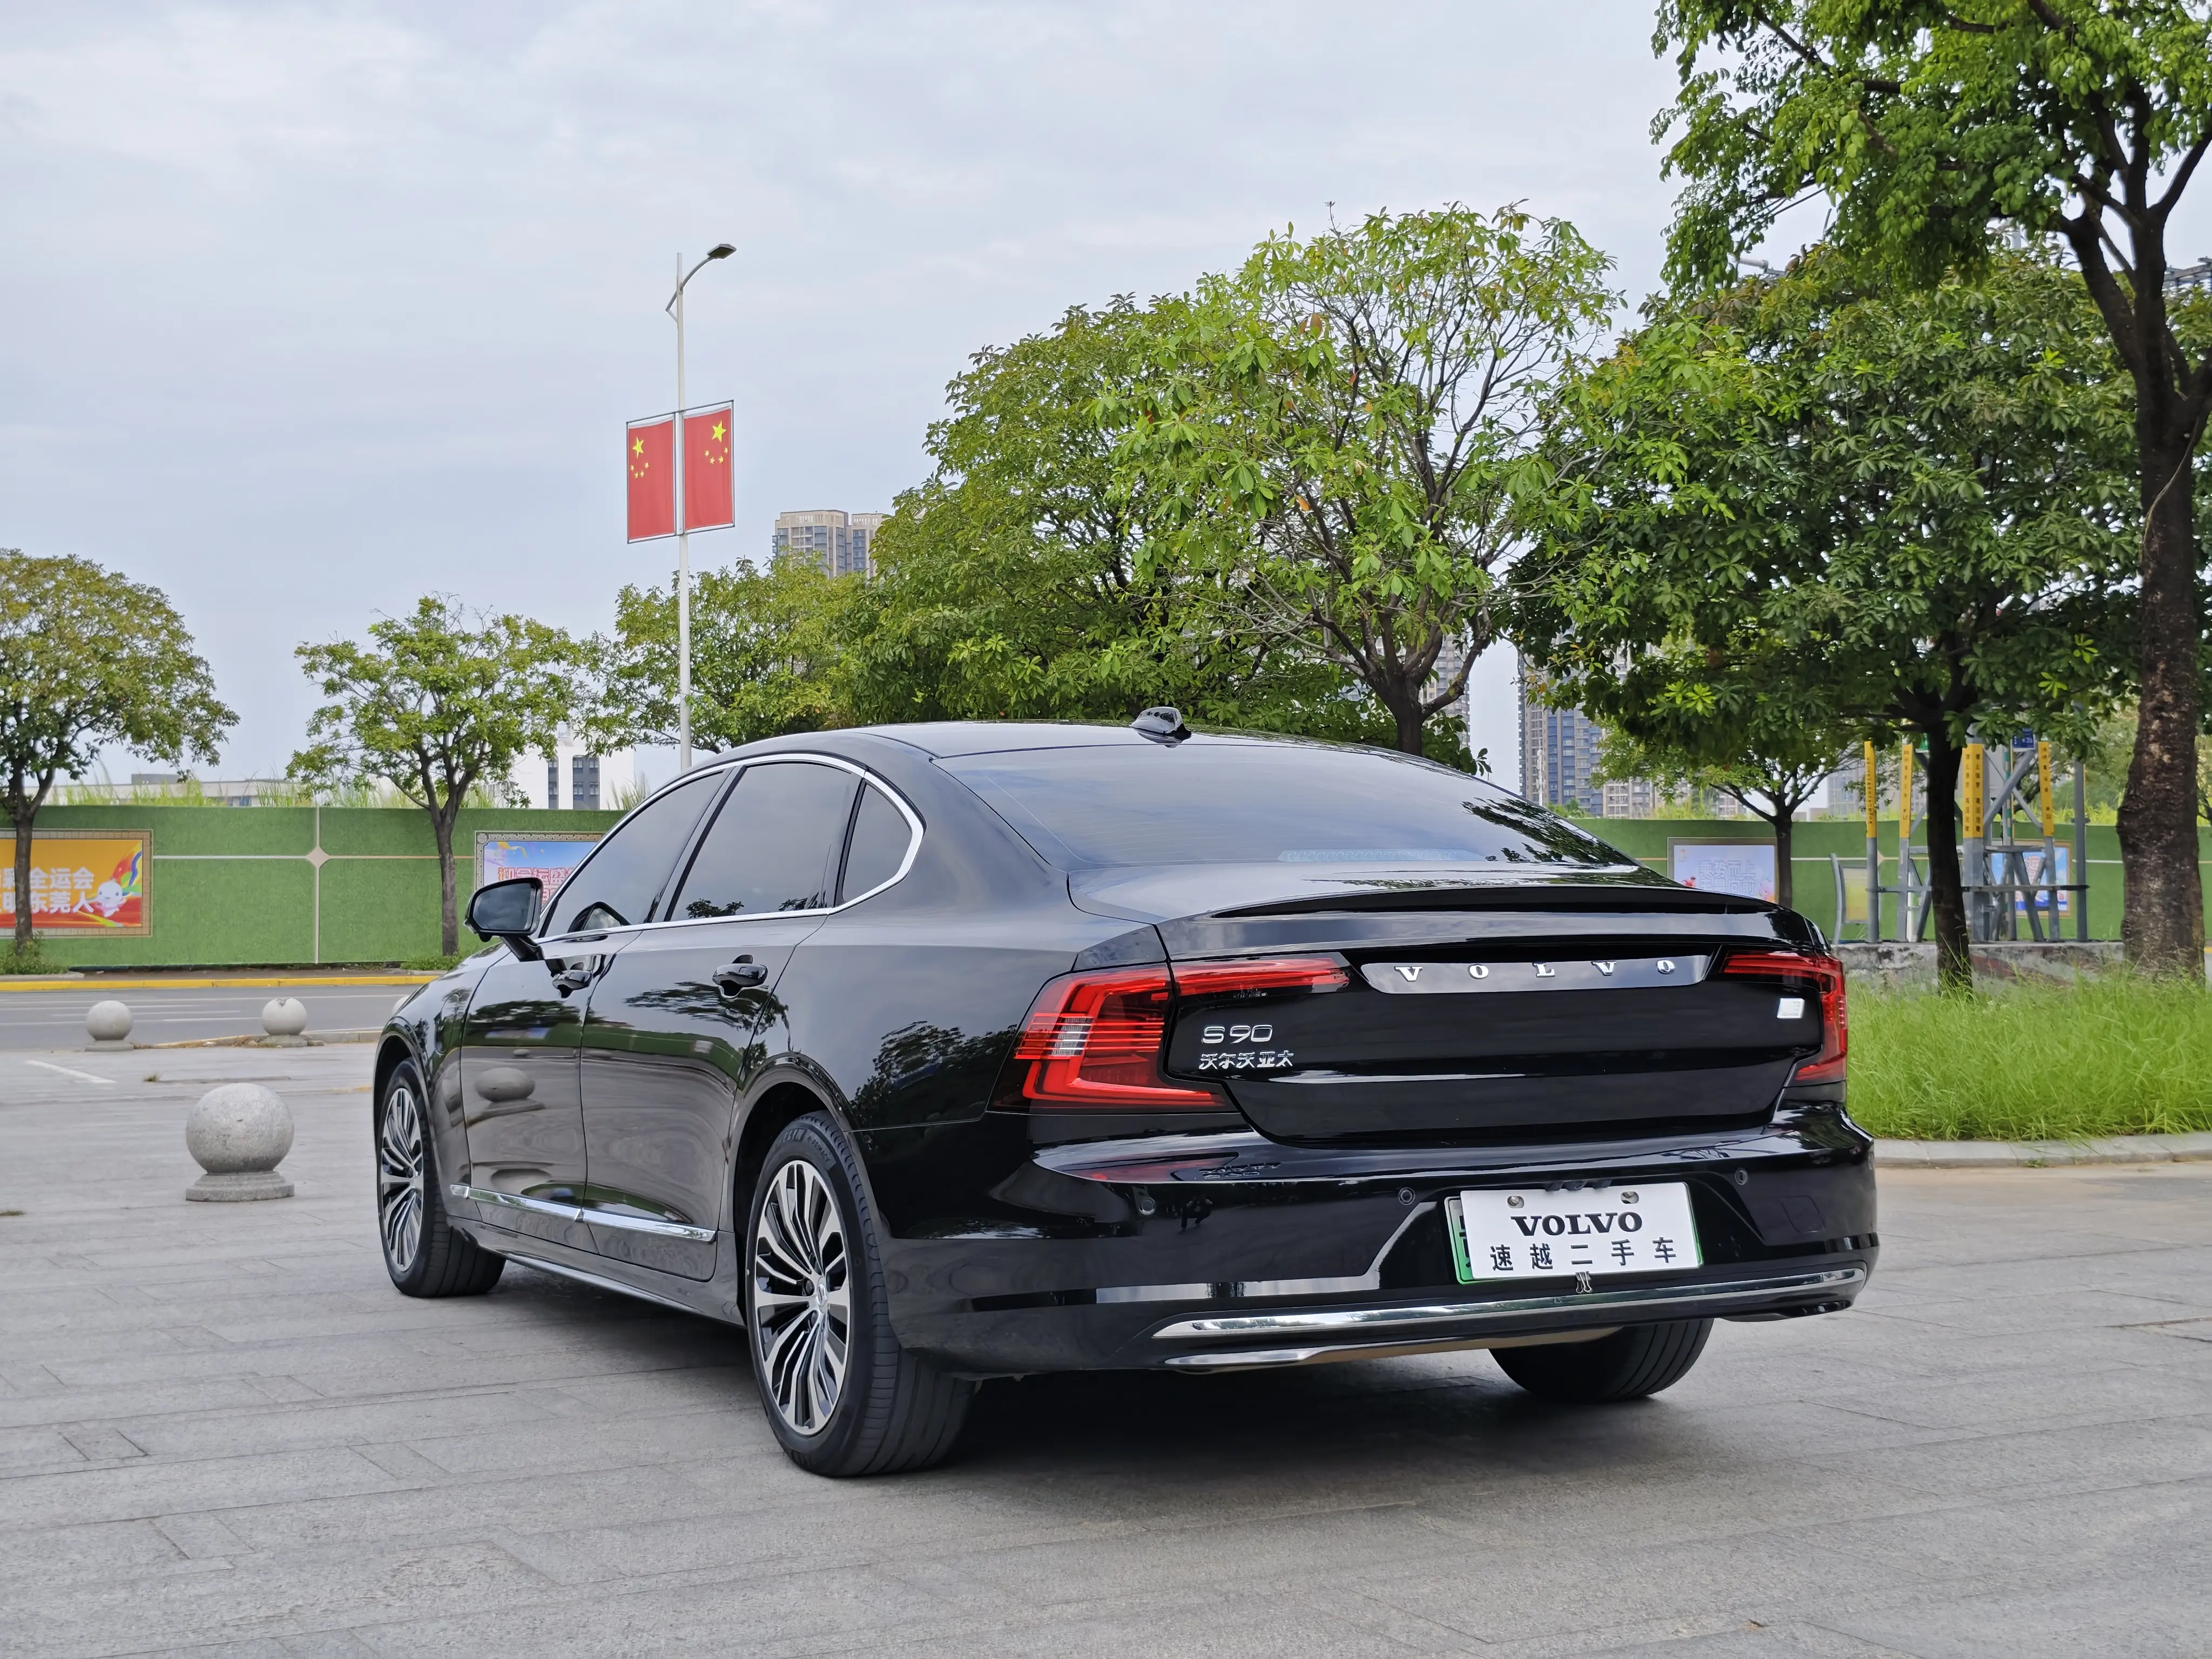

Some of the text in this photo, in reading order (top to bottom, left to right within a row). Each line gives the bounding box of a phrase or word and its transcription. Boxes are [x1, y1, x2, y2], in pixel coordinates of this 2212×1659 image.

[0, 866, 95, 889] 彩全运会
[0, 891, 95, 914] 明东莞人
[1394, 960, 1675, 982] VOLVO
[1201, 1024, 1273, 1044] S90
[1198, 1050, 1294, 1069] 沃尔沃亚太
[1510, 1211, 1642, 1236] VOLVO
[1490, 1236, 1676, 1271] 速越二手车
